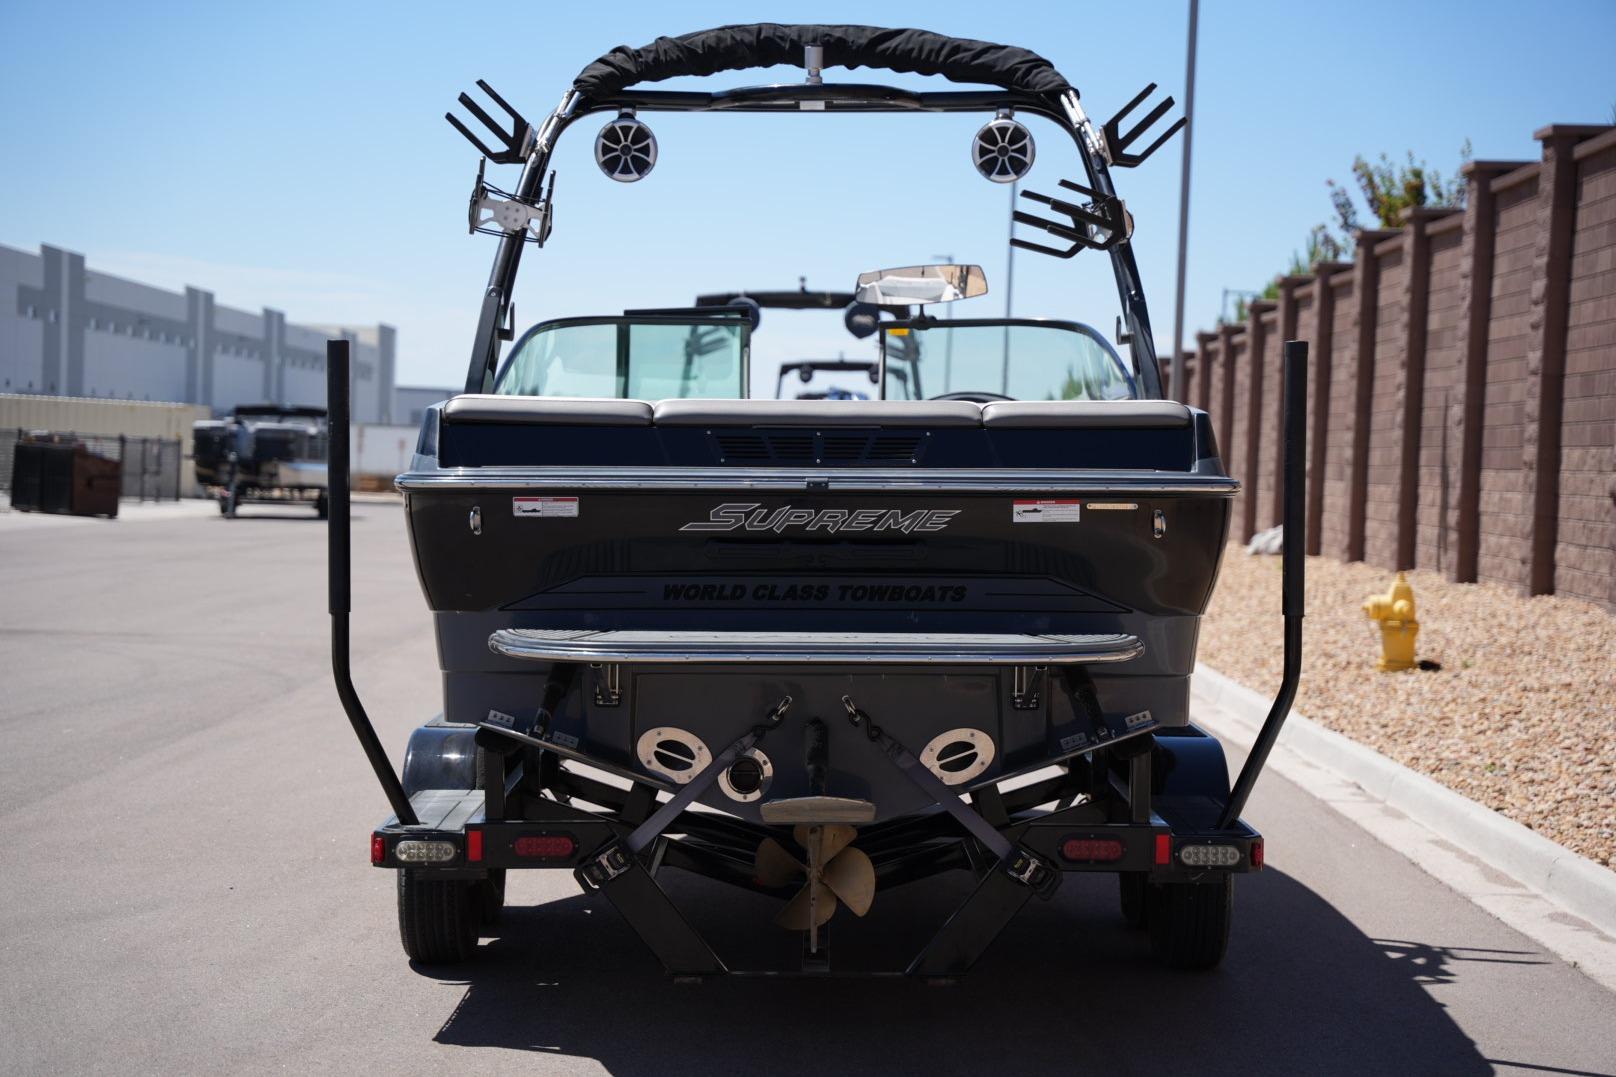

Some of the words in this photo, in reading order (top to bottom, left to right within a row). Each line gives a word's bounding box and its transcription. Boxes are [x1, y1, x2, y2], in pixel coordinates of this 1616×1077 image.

[678, 503, 962, 534] SUPREME
[663, 584, 747, 600] WORLD
[752, 584, 829, 601] CLASS
[837, 585, 967, 602] TOWBOATS
